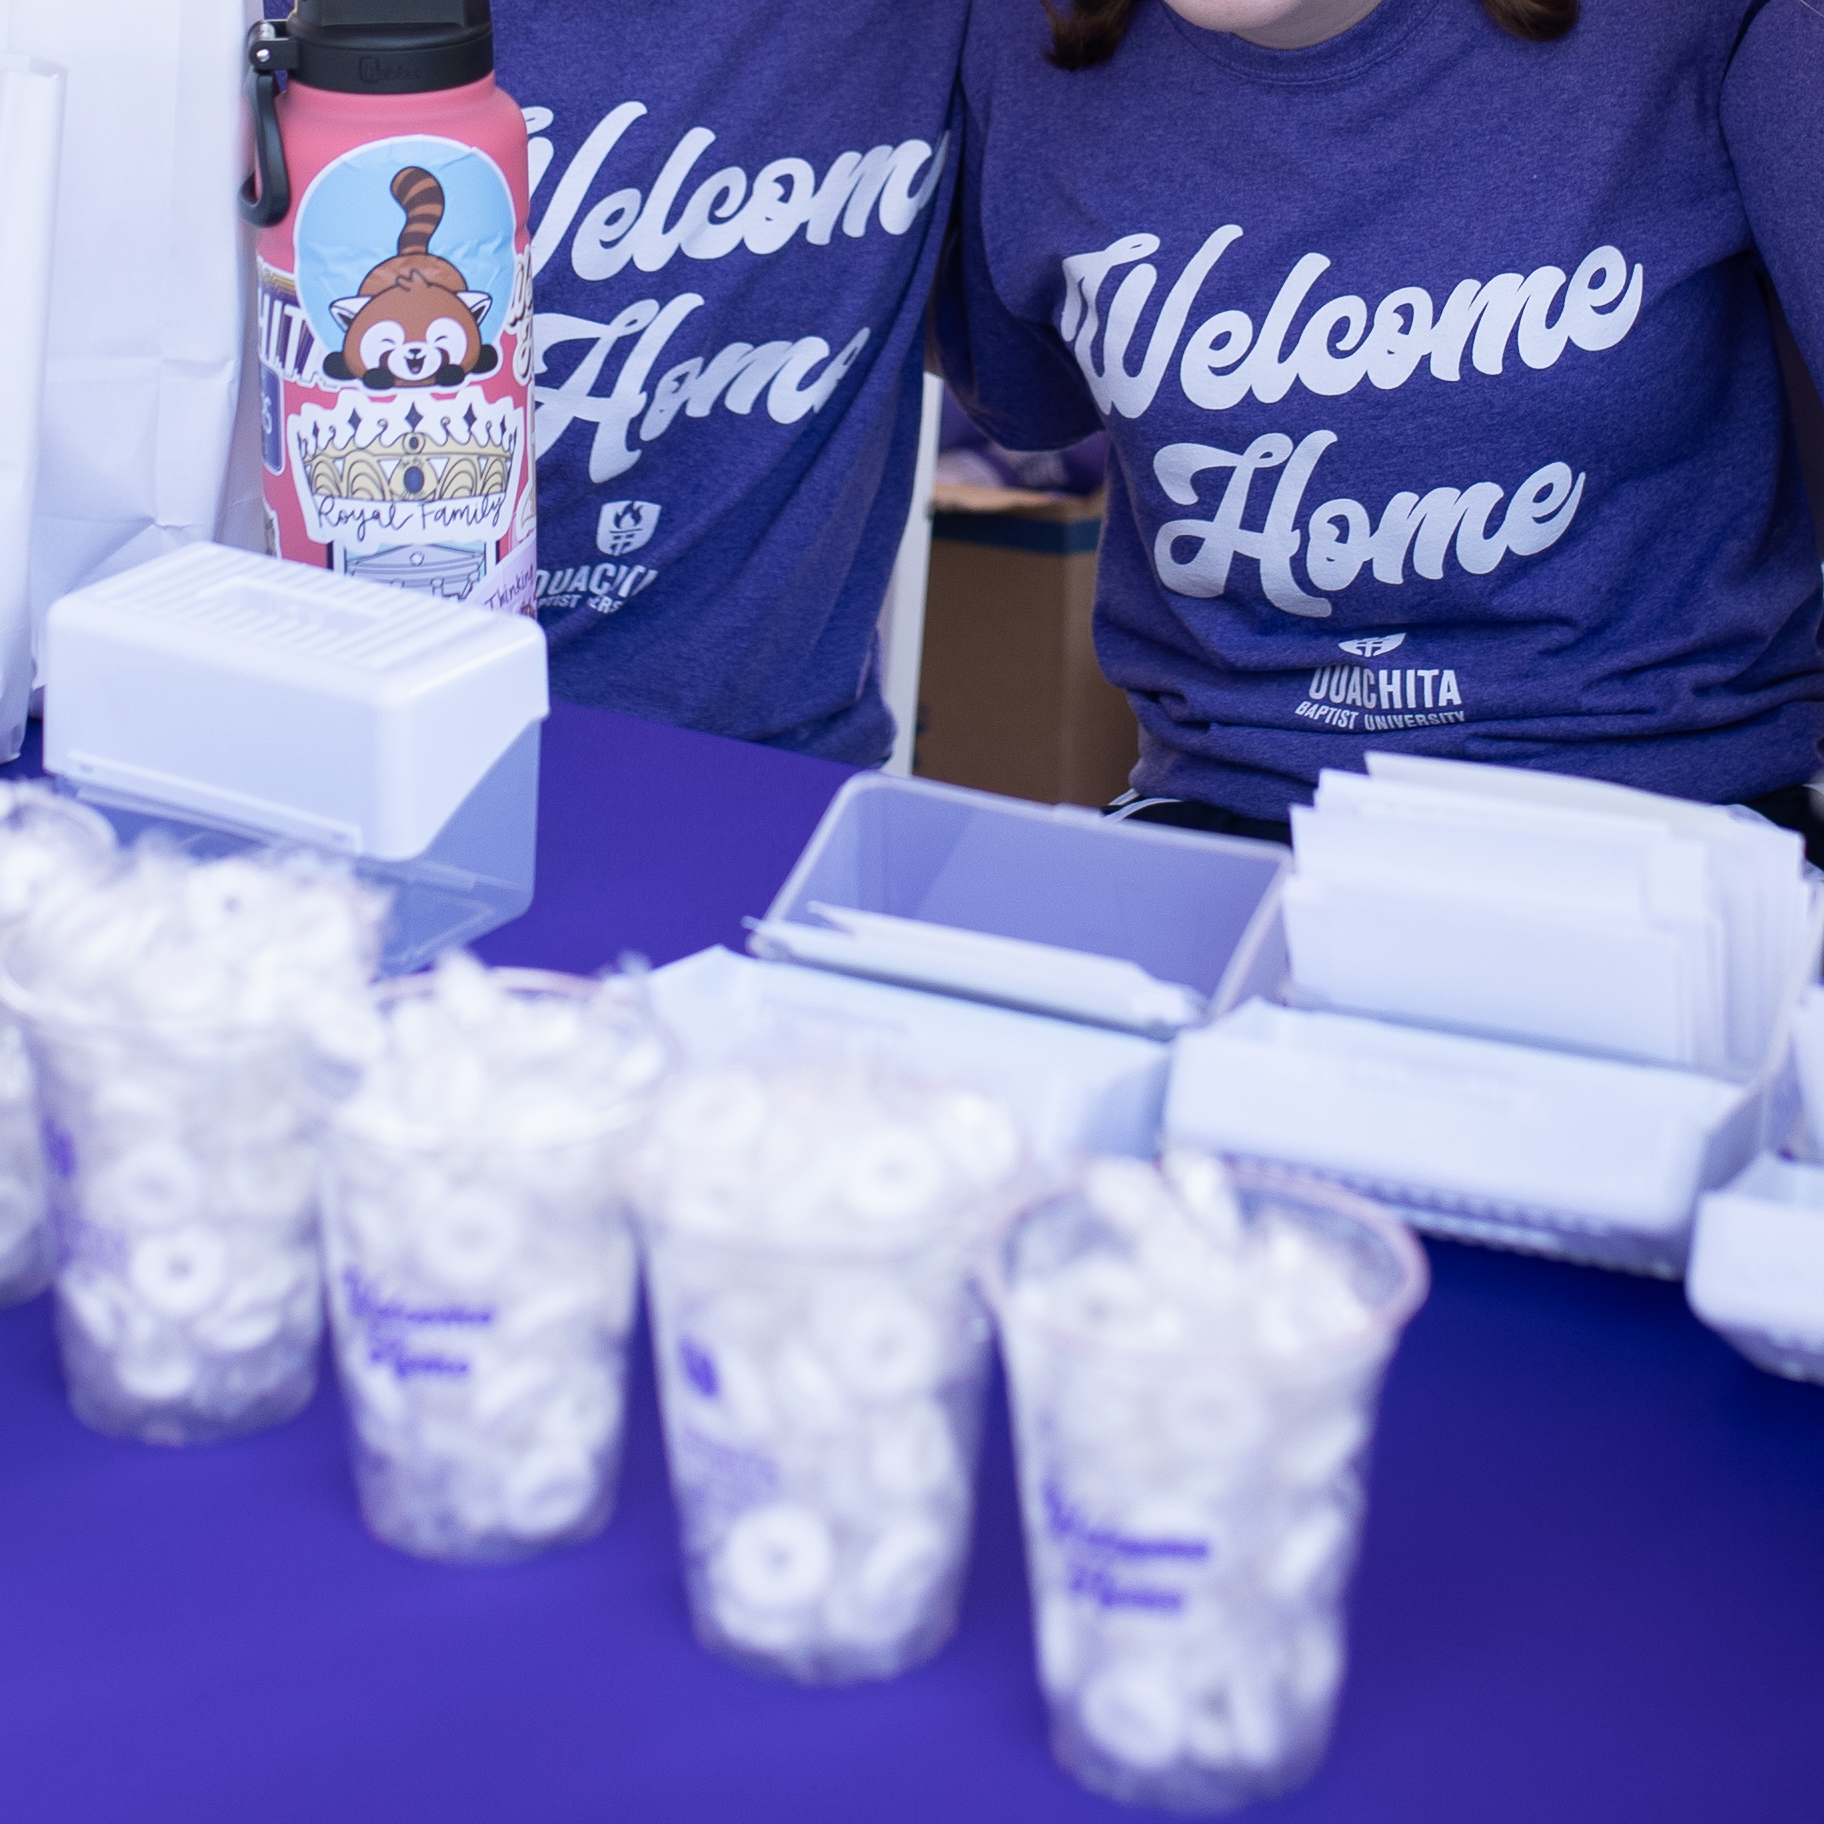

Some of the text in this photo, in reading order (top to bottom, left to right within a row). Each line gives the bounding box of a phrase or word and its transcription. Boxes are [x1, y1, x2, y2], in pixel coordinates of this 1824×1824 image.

[519, 101, 951, 282] Welcom
[1061, 223, 1644, 419] Welcome
[318, 491, 508, 542] Royal Family
[1152, 429, 1586, 618] Home
[1294, 700, 1466, 732] BAPTIST UNIVERSITY
[1308, 663, 1463, 710] OUACHITA
